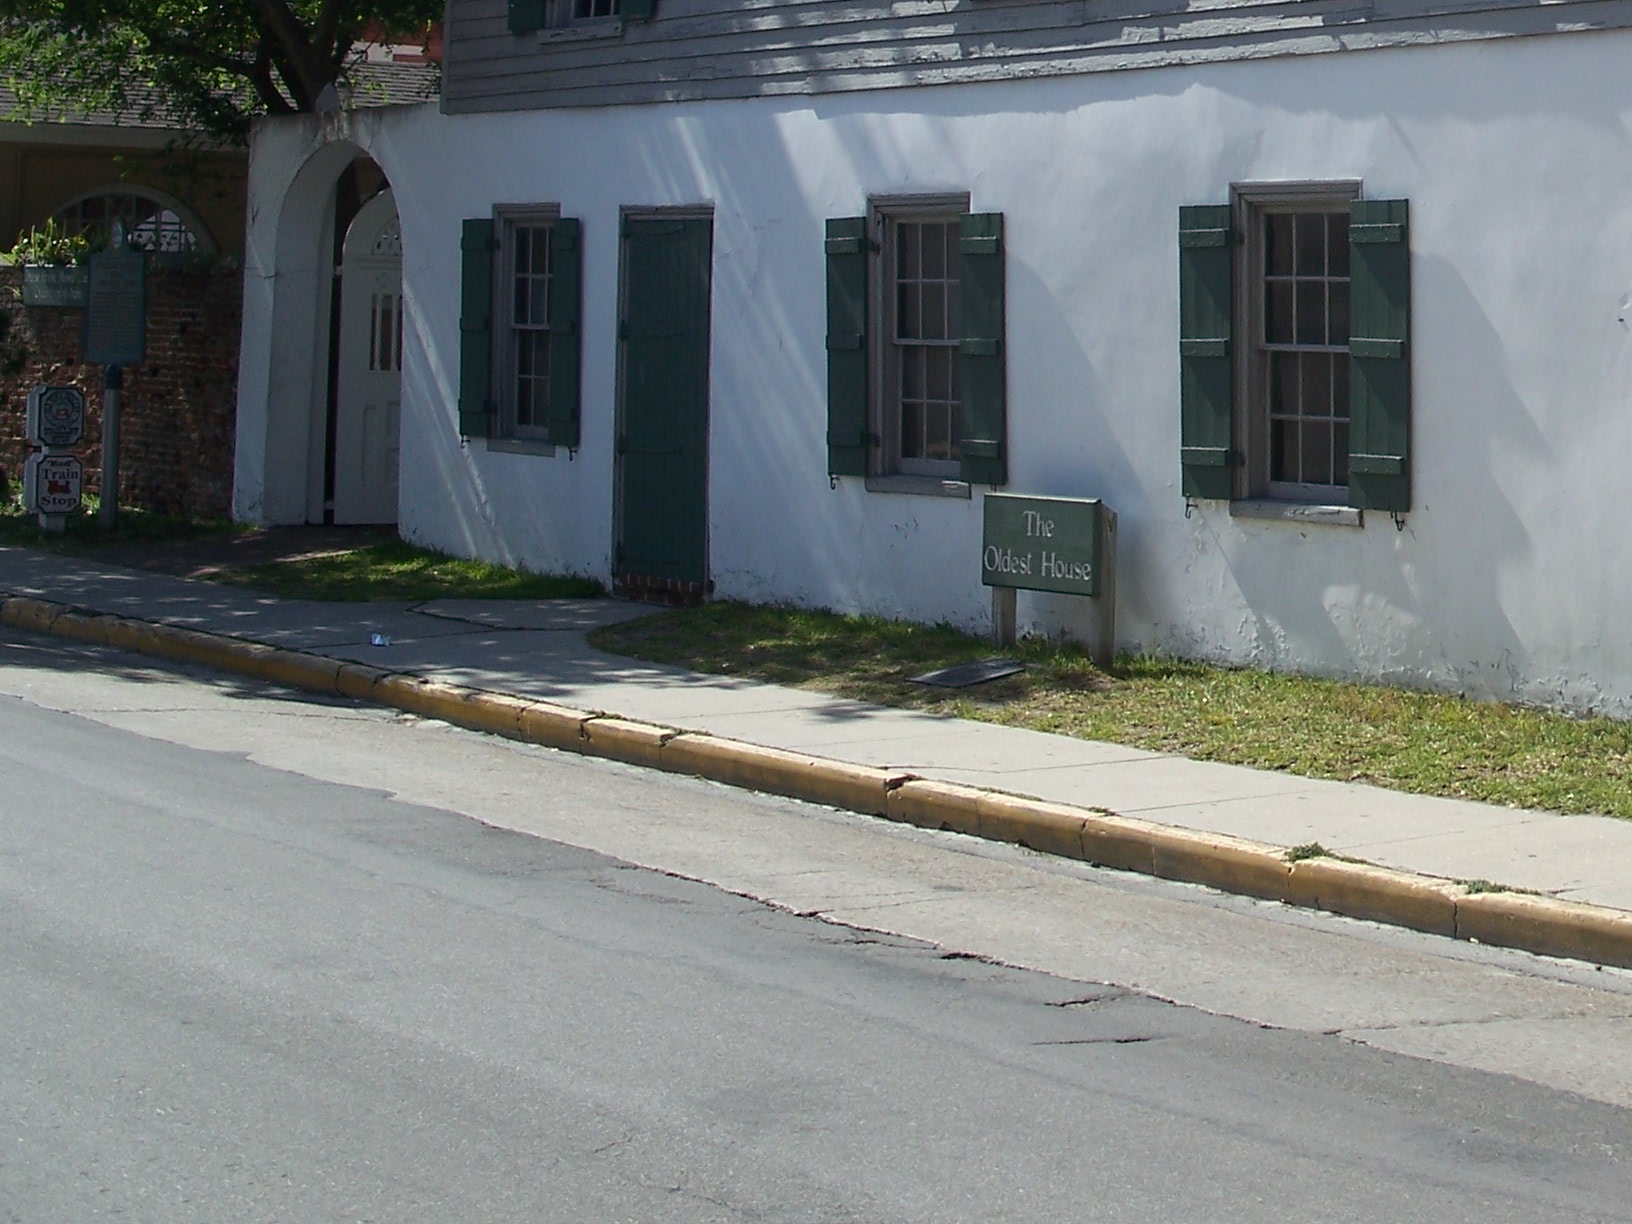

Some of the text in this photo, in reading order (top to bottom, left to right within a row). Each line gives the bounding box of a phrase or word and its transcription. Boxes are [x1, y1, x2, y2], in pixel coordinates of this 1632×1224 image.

[42, 468, 79, 480] Train
[42, 495, 77, 507] Stop
[1023, 511, 1055, 538] The
[984, 546, 1092, 581] Oldest House
